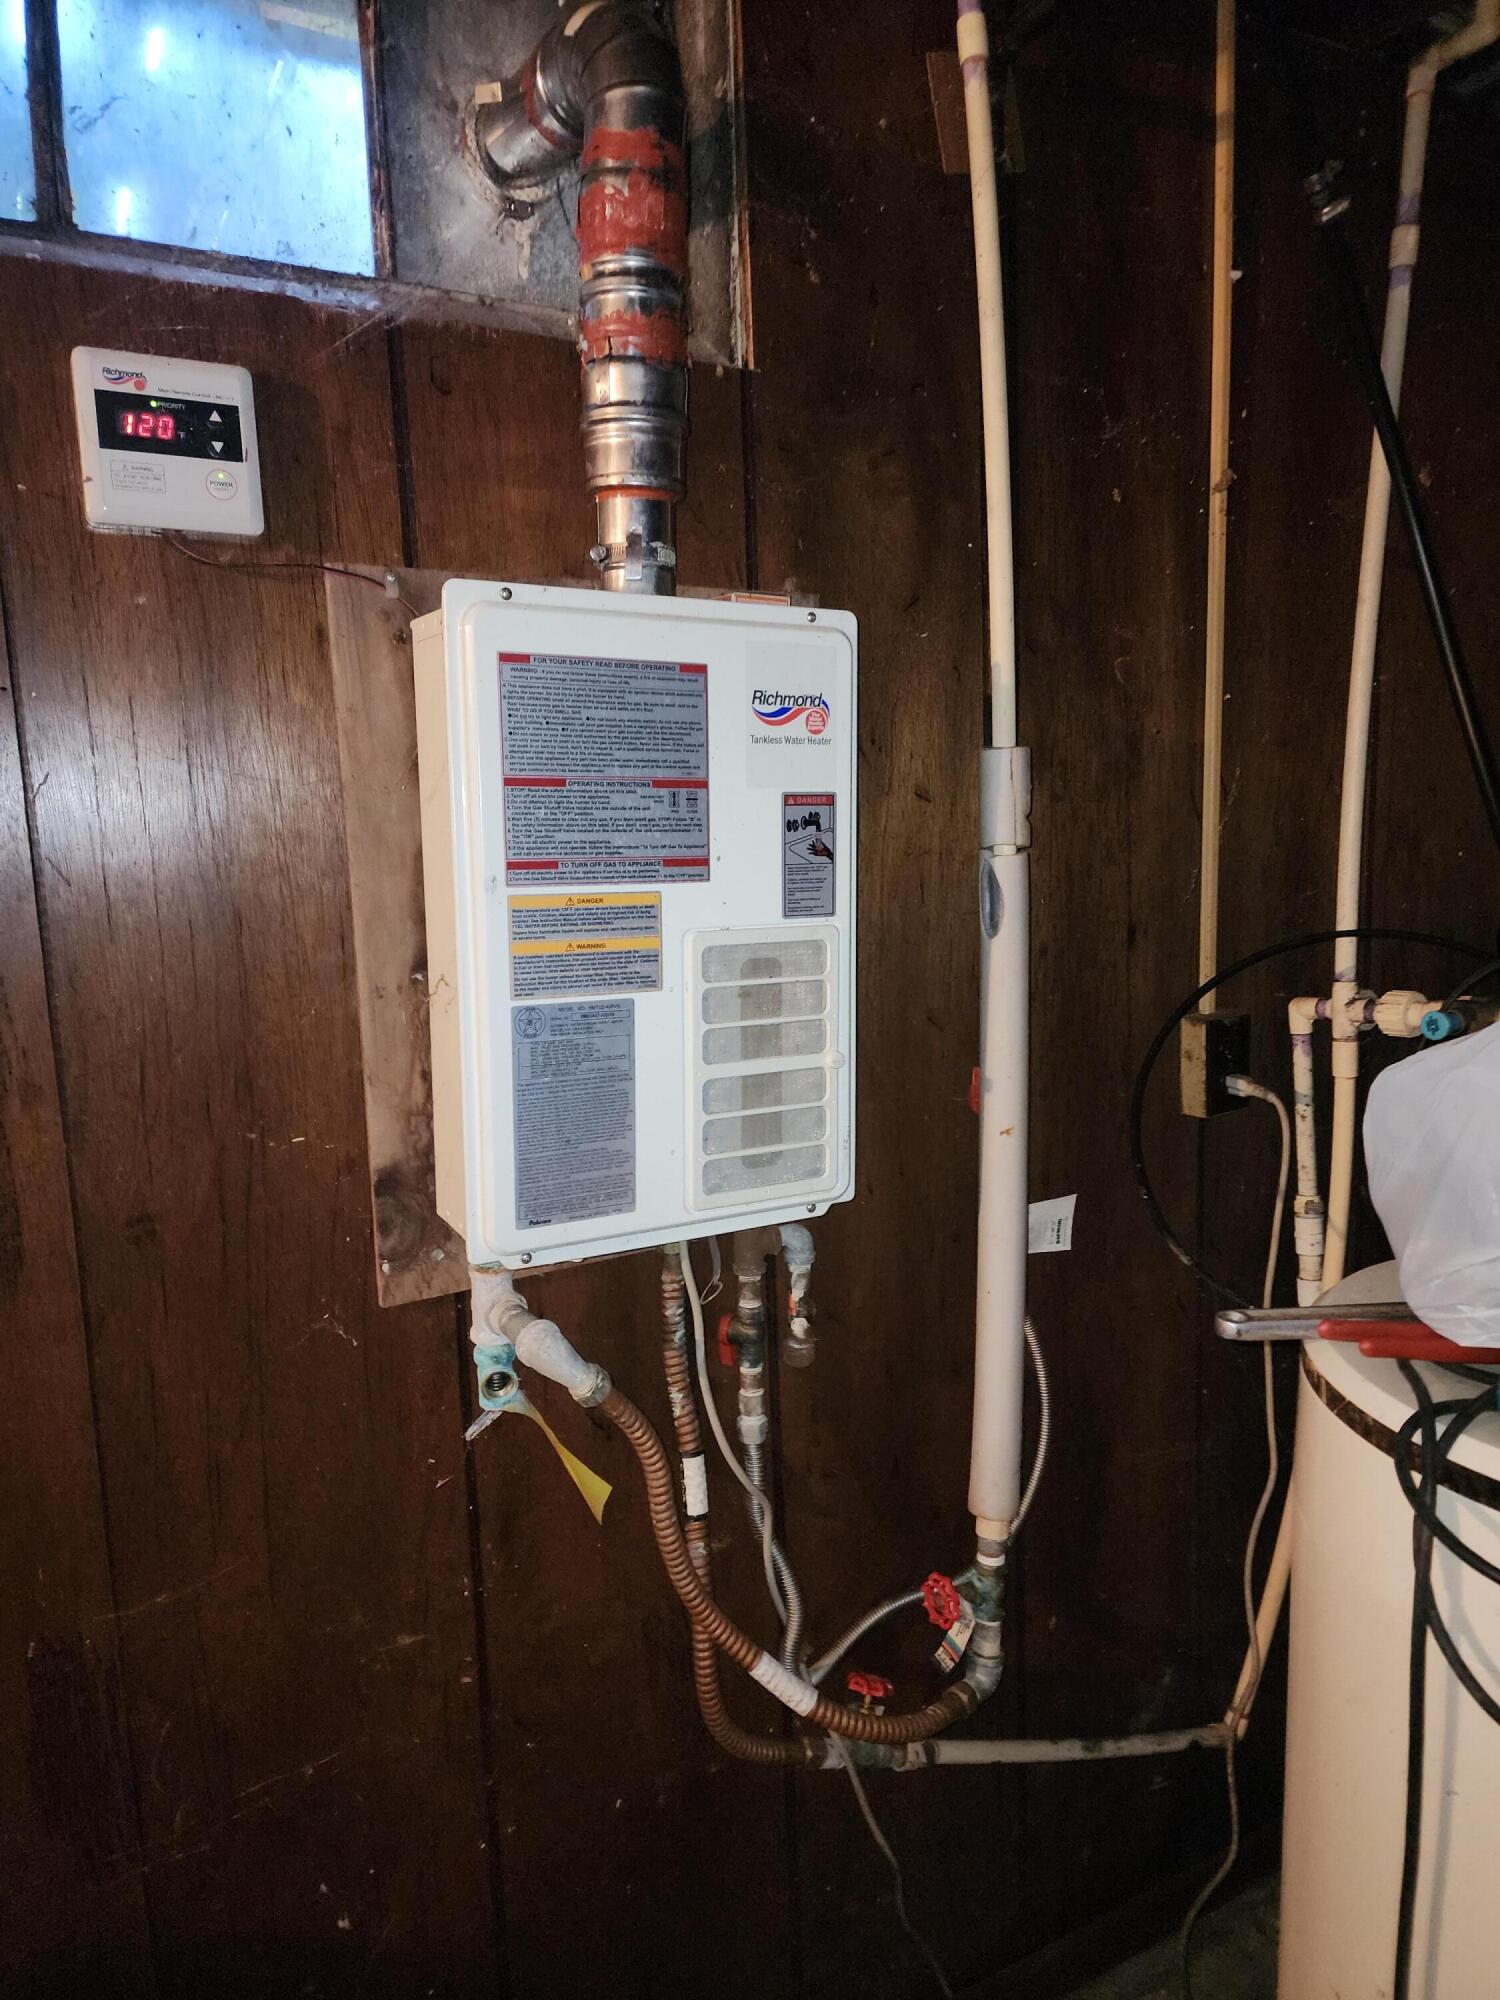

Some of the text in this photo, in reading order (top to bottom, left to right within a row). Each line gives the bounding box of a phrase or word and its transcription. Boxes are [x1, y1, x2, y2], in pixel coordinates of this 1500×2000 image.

[102, 366, 143, 378] Richmond
[157, 402, 186, 410] PRIORITY
[123, 412, 175, 440] 120
[533, 656, 676, 672] FOR YOUR SAFETY READ BEFORE OPERATING
[752, 689, 823, 707] Richmond
[750, 734, 832, 745] Tankless Water Heater
[796, 795, 828, 804] DANGER
